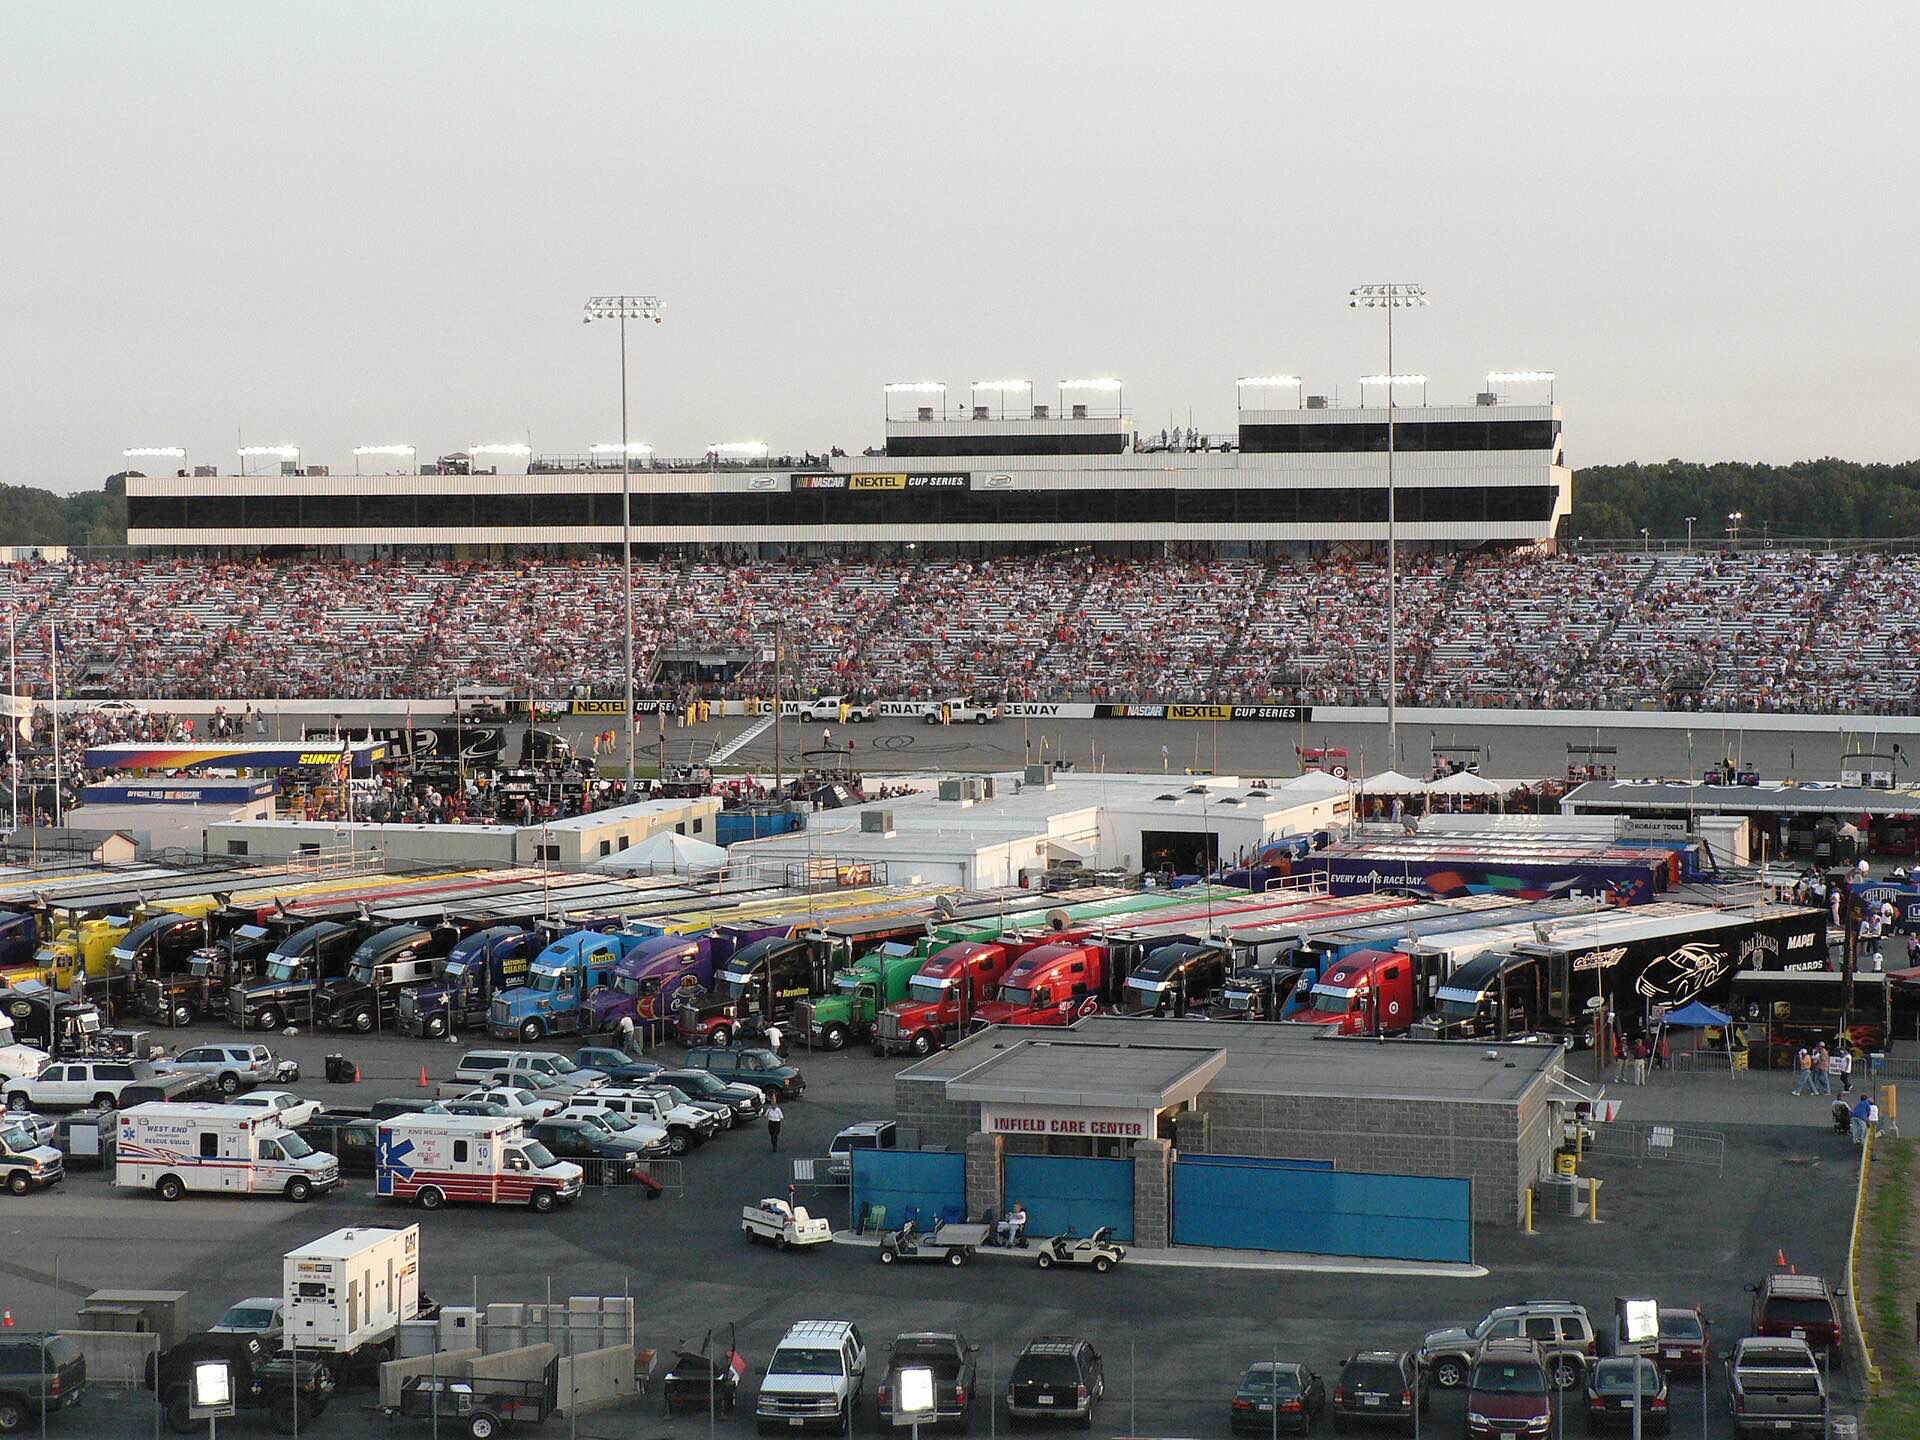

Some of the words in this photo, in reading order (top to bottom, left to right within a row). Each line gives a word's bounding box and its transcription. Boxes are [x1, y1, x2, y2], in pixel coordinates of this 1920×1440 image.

[812, 477, 846, 488] NASCAR
[855, 477, 900, 488] NEXTEL
[908, 477, 928, 486] CUP
[930, 476, 964, 486] SERIES
[636, 702, 656, 711] CUP
[1128, 705, 1164, 717] NASCAR
[1173, 706, 1226, 717] NEXTEL
[1234, 707, 1256, 717] CUP
[1258, 708, 1296, 718] SERIES
[1330, 875, 1356, 883] EVERY
[1406, 877, 1423, 885] DAY
[1787, 933, 1816, 950] MAPEI
[503, 966, 528, 974] GUARD
[1783, 960, 1823, 973] MENARDS
[1296, 979, 1308, 991] 96
[1078, 995, 1098, 1017] 6
[994, 1118, 1045, 1131] INFIELD
[1051, 1120, 1086, 1133] CARE
[1091, 1122, 1142, 1135] CENTER
[170, 1138, 190, 1146] SQUAD
[478, 1147, 488, 1158] 10
[404, 1232, 417, 1254] CAT
